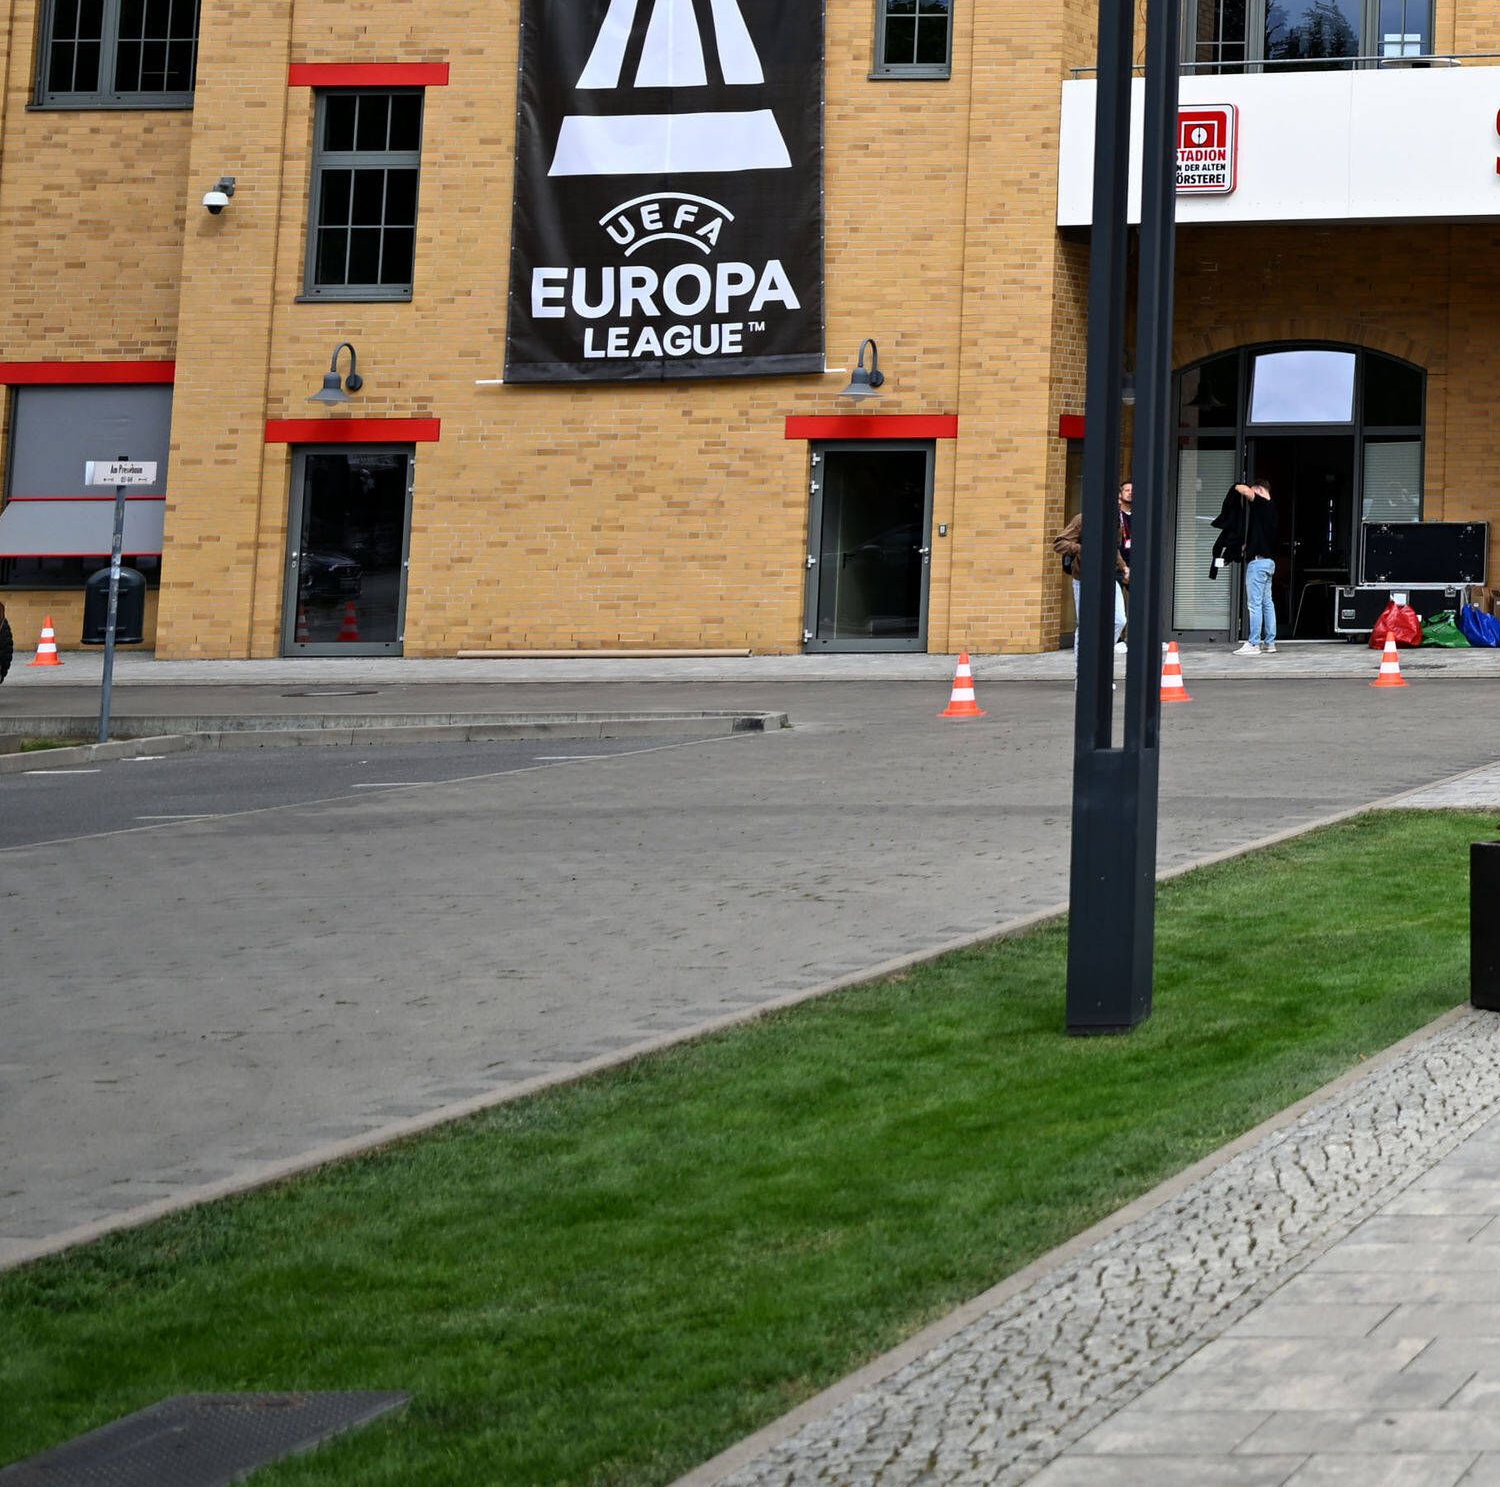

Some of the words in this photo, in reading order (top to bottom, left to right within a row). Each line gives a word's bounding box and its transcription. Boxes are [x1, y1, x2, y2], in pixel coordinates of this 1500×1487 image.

[1177, 150, 1226, 161] TADION
[1202, 163, 1226, 171] ALTEN
[1176, 172, 1225, 184] ÖRSTEREI
[606, 202, 724, 247] UEFA
[531, 259, 801, 319] EUROPA
